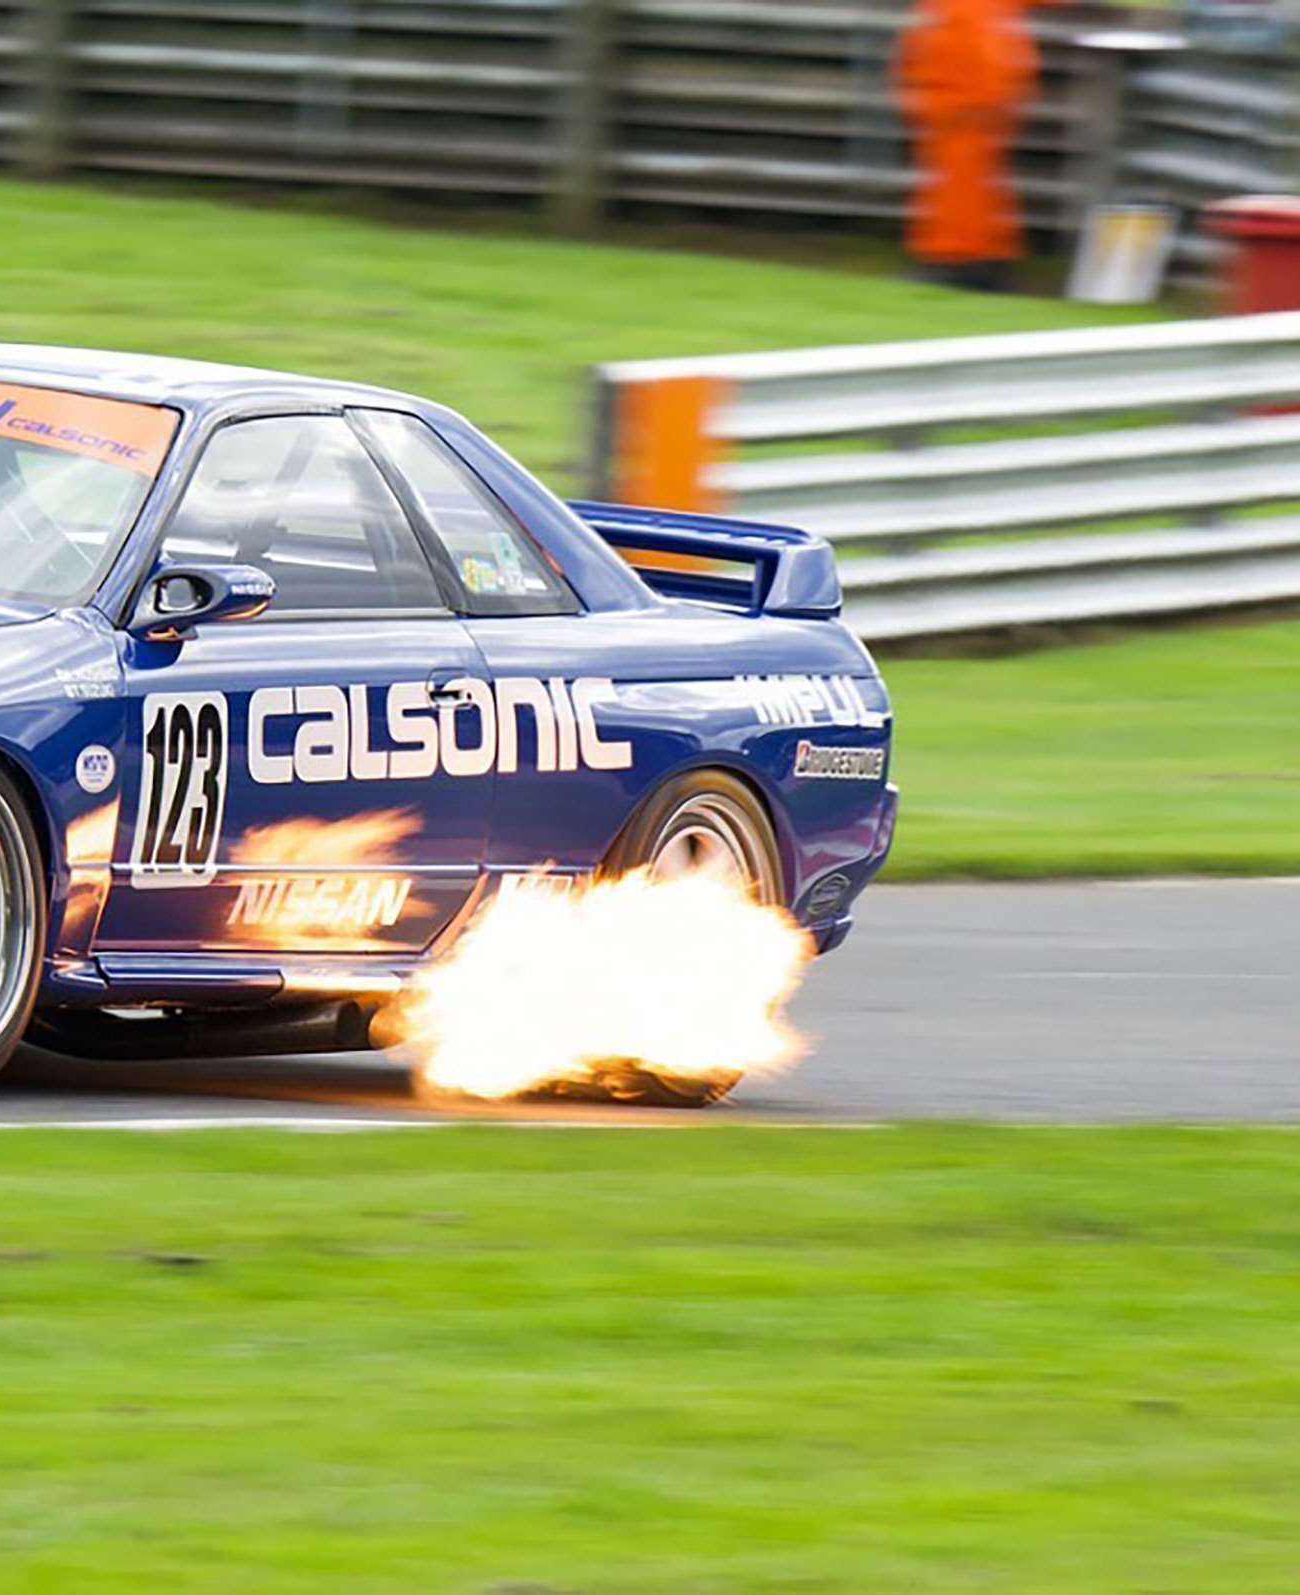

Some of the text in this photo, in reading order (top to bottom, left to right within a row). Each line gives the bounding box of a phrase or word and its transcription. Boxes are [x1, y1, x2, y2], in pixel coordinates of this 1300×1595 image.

[231, 583, 273, 597] NISS
[734, 674, 886, 728] IMPUL
[795, 741, 884, 779] BRIDGESTONE
[139, 703, 223, 874] 123
[225, 878, 413, 927] NISSAN
